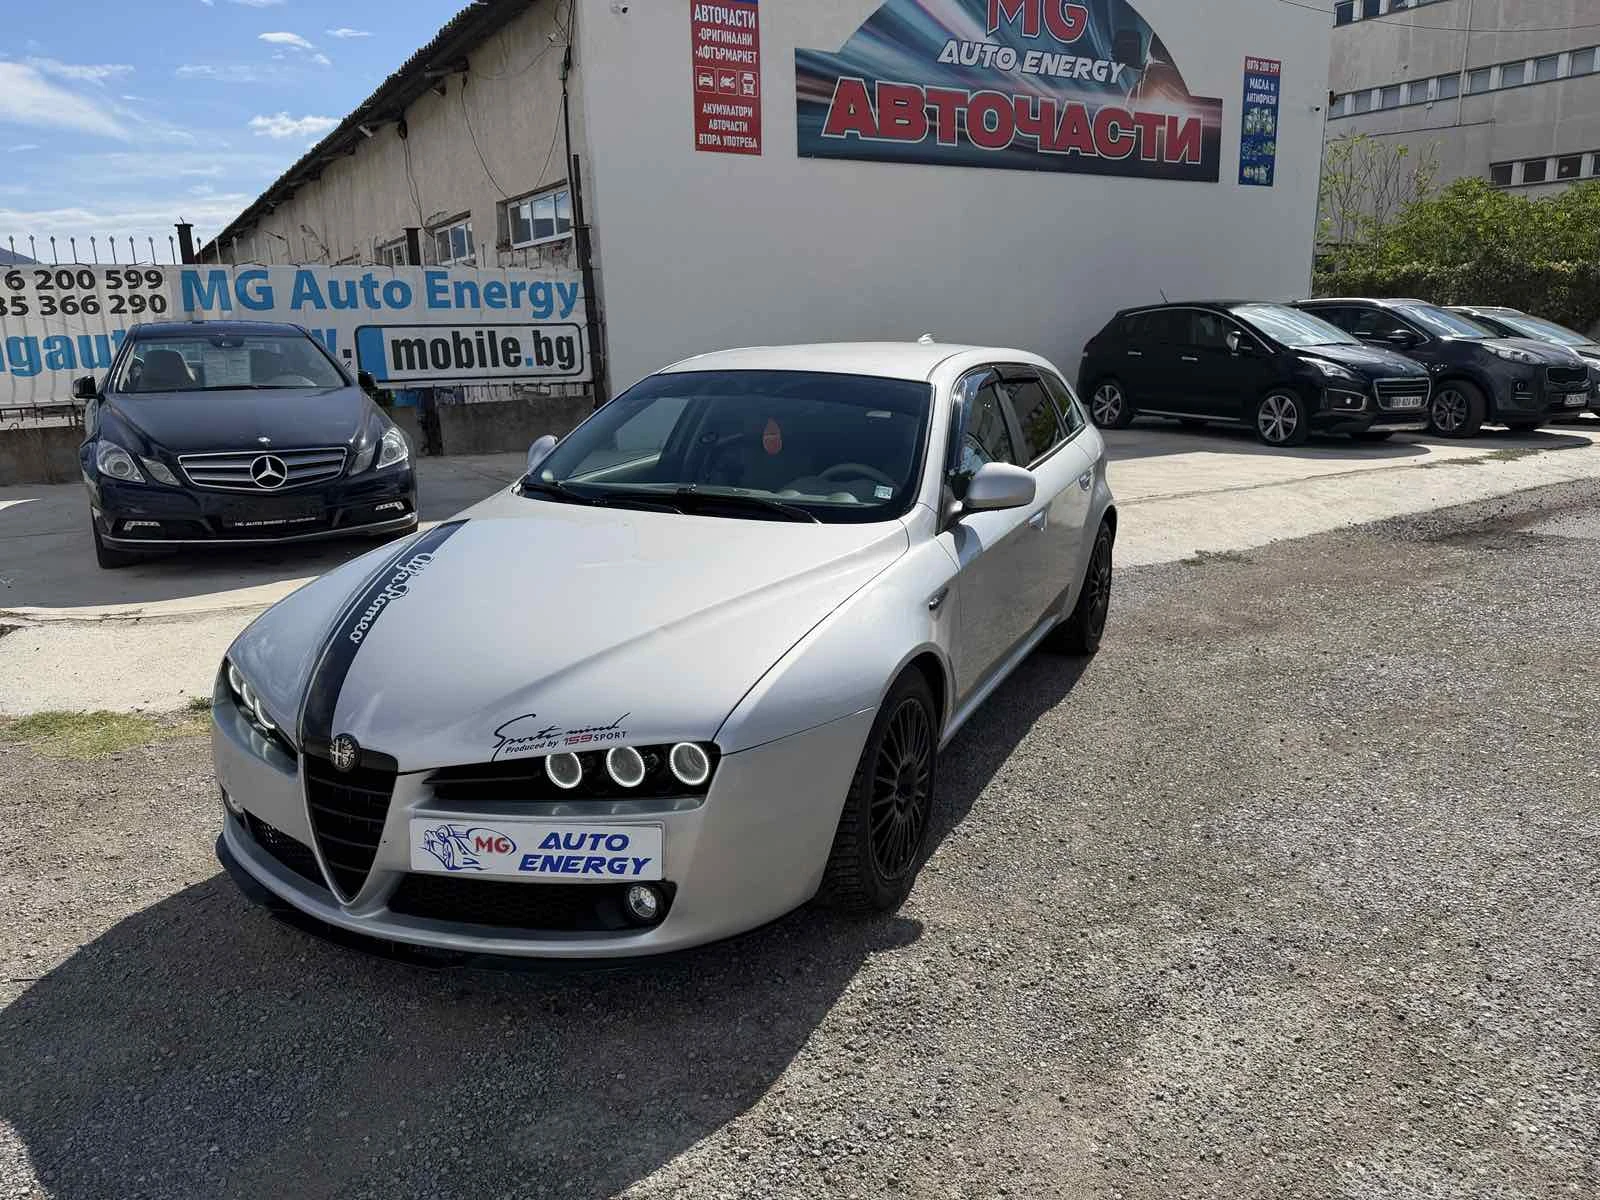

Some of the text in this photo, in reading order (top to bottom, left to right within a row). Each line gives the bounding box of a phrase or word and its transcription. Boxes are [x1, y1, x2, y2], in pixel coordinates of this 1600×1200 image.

[694, 4, 756, 29] АВТОЧАСТИ
[986, 0, 1089, 43] MG
[937, 40, 1126, 84] AUTO ENERGY
[708, 119, 748, 132] АВТОЧАСТИ
[821, 76, 1203, 164] АВТОЧАСТИ
[699, 133, 758, 148] ВТОРА УПОТРЕБА
[33, 269, 96, 290] 200
[105, 269, 164, 290] 599
[38, 294, 101, 316] 366
[108, 294, 167, 315] 290
[180, 269, 579, 319] MG Auto Energy
[0, 329, 127, 377] gau
[391, 329, 575, 370] mobile.bg
[505, 741, 545, 754] Produced
[547, 739, 560, 749] by
[474, 835, 511, 854] MG
[538, 831, 630, 852] AUTO
[518, 854, 653, 875] ENERGY
